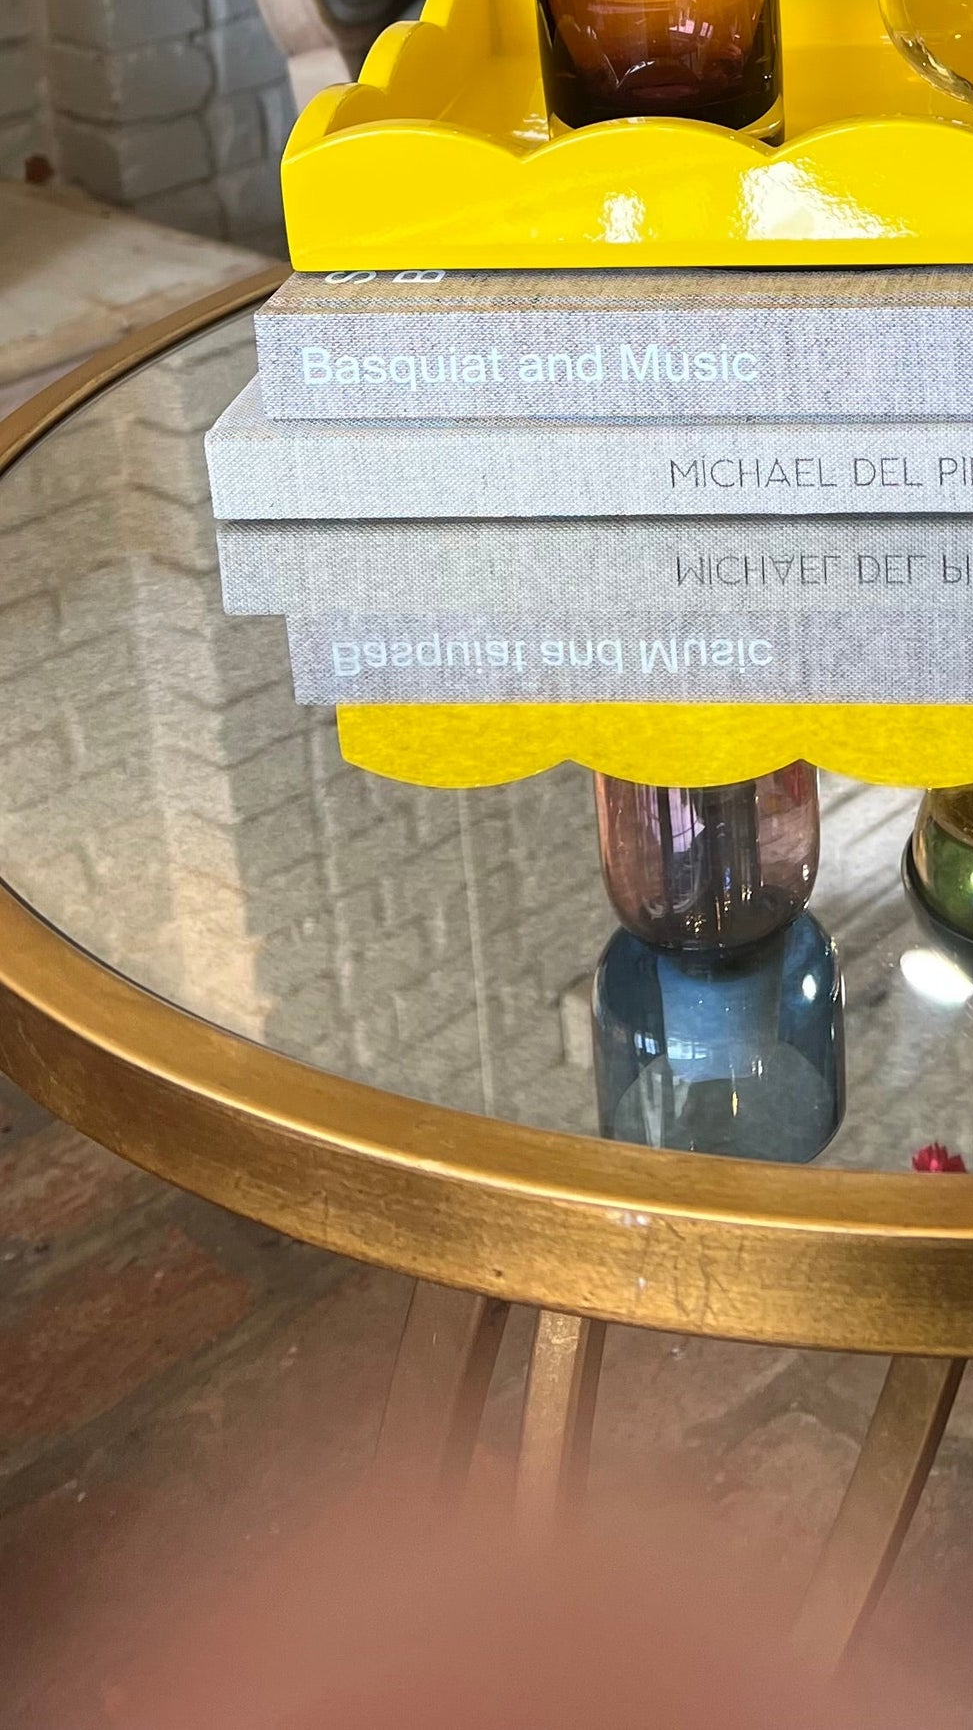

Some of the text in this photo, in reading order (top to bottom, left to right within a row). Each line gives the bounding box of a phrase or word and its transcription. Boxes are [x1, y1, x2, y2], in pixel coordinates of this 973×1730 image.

[301, 343, 760, 391] Basquiat and Music
[669, 457, 838, 488] MICHAEL
[853, 457, 923, 486] DEL
